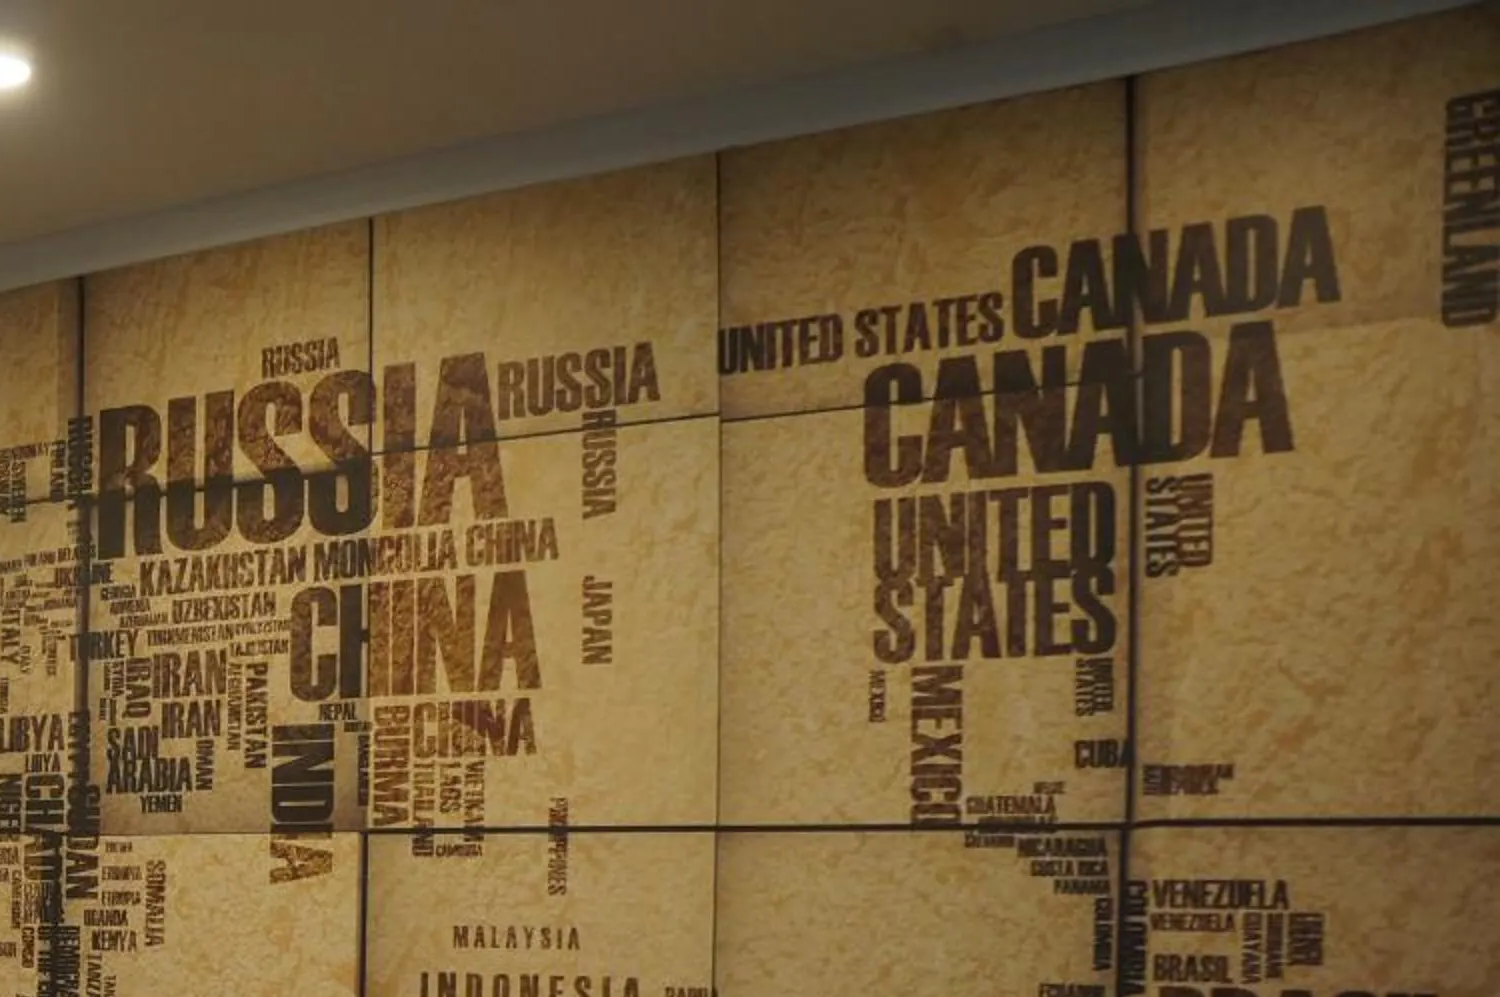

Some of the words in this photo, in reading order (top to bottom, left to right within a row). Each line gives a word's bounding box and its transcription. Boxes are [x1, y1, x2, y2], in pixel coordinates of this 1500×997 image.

[1441, 88, 1500, 330] GREENLAND
[1011, 205, 1342, 339] CANADA
[261, 337, 340, 380] RUSSIA
[718, 313, 843, 376] UNITED
[855, 292, 1004, 356] STATES
[498, 341, 662, 420] RUSSIA
[862, 319, 1297, 489] CANADA
[98, 351, 510, 561] RUSSIA
[581, 408, 617, 520] RUSSIA
[139, 545, 307, 597] KAZAKHSTAN
[314, 528, 458, 585] MONGOLIA
[464, 516, 560, 567] CHINA
[873, 481, 1115, 581] UNITED
[1146, 476, 1180, 578] STATES
[0, 609, 20, 664] ITALY
[68, 627, 139, 662] TRKEY
[289, 569, 543, 703] CHINA
[581, 573, 614, 666] JAPAN
[872, 567, 1116, 664] STATES
[125, 657, 151, 719] IRAQ
[152, 649, 228, 698] IRAN
[318, 702, 358, 721] NEPAL
[161, 699, 222, 739] IRAN
[244, 661, 269, 769] PAKISTAN
[413, 696, 539, 759] CHINA
[909, 664, 965, 826] MEXICO
[1074, 738, 1135, 769] CUBA
[106, 756, 193, 794] ARABIA
[195, 738, 215, 791] OMAN
[268, 722, 335, 886] INDIA
[372, 705, 411, 827] BURMA
[439, 760, 463, 816] LAOS
[67, 784, 101, 899] SUDAN
[547, 796, 570, 897] PHILIPPINES
[1152, 879, 1291, 911] VENEZUELA
[90, 927, 138, 952] KENYA
[452, 924, 581, 952] MALAYSIA
[1153, 953, 1234, 984] BRASIL
